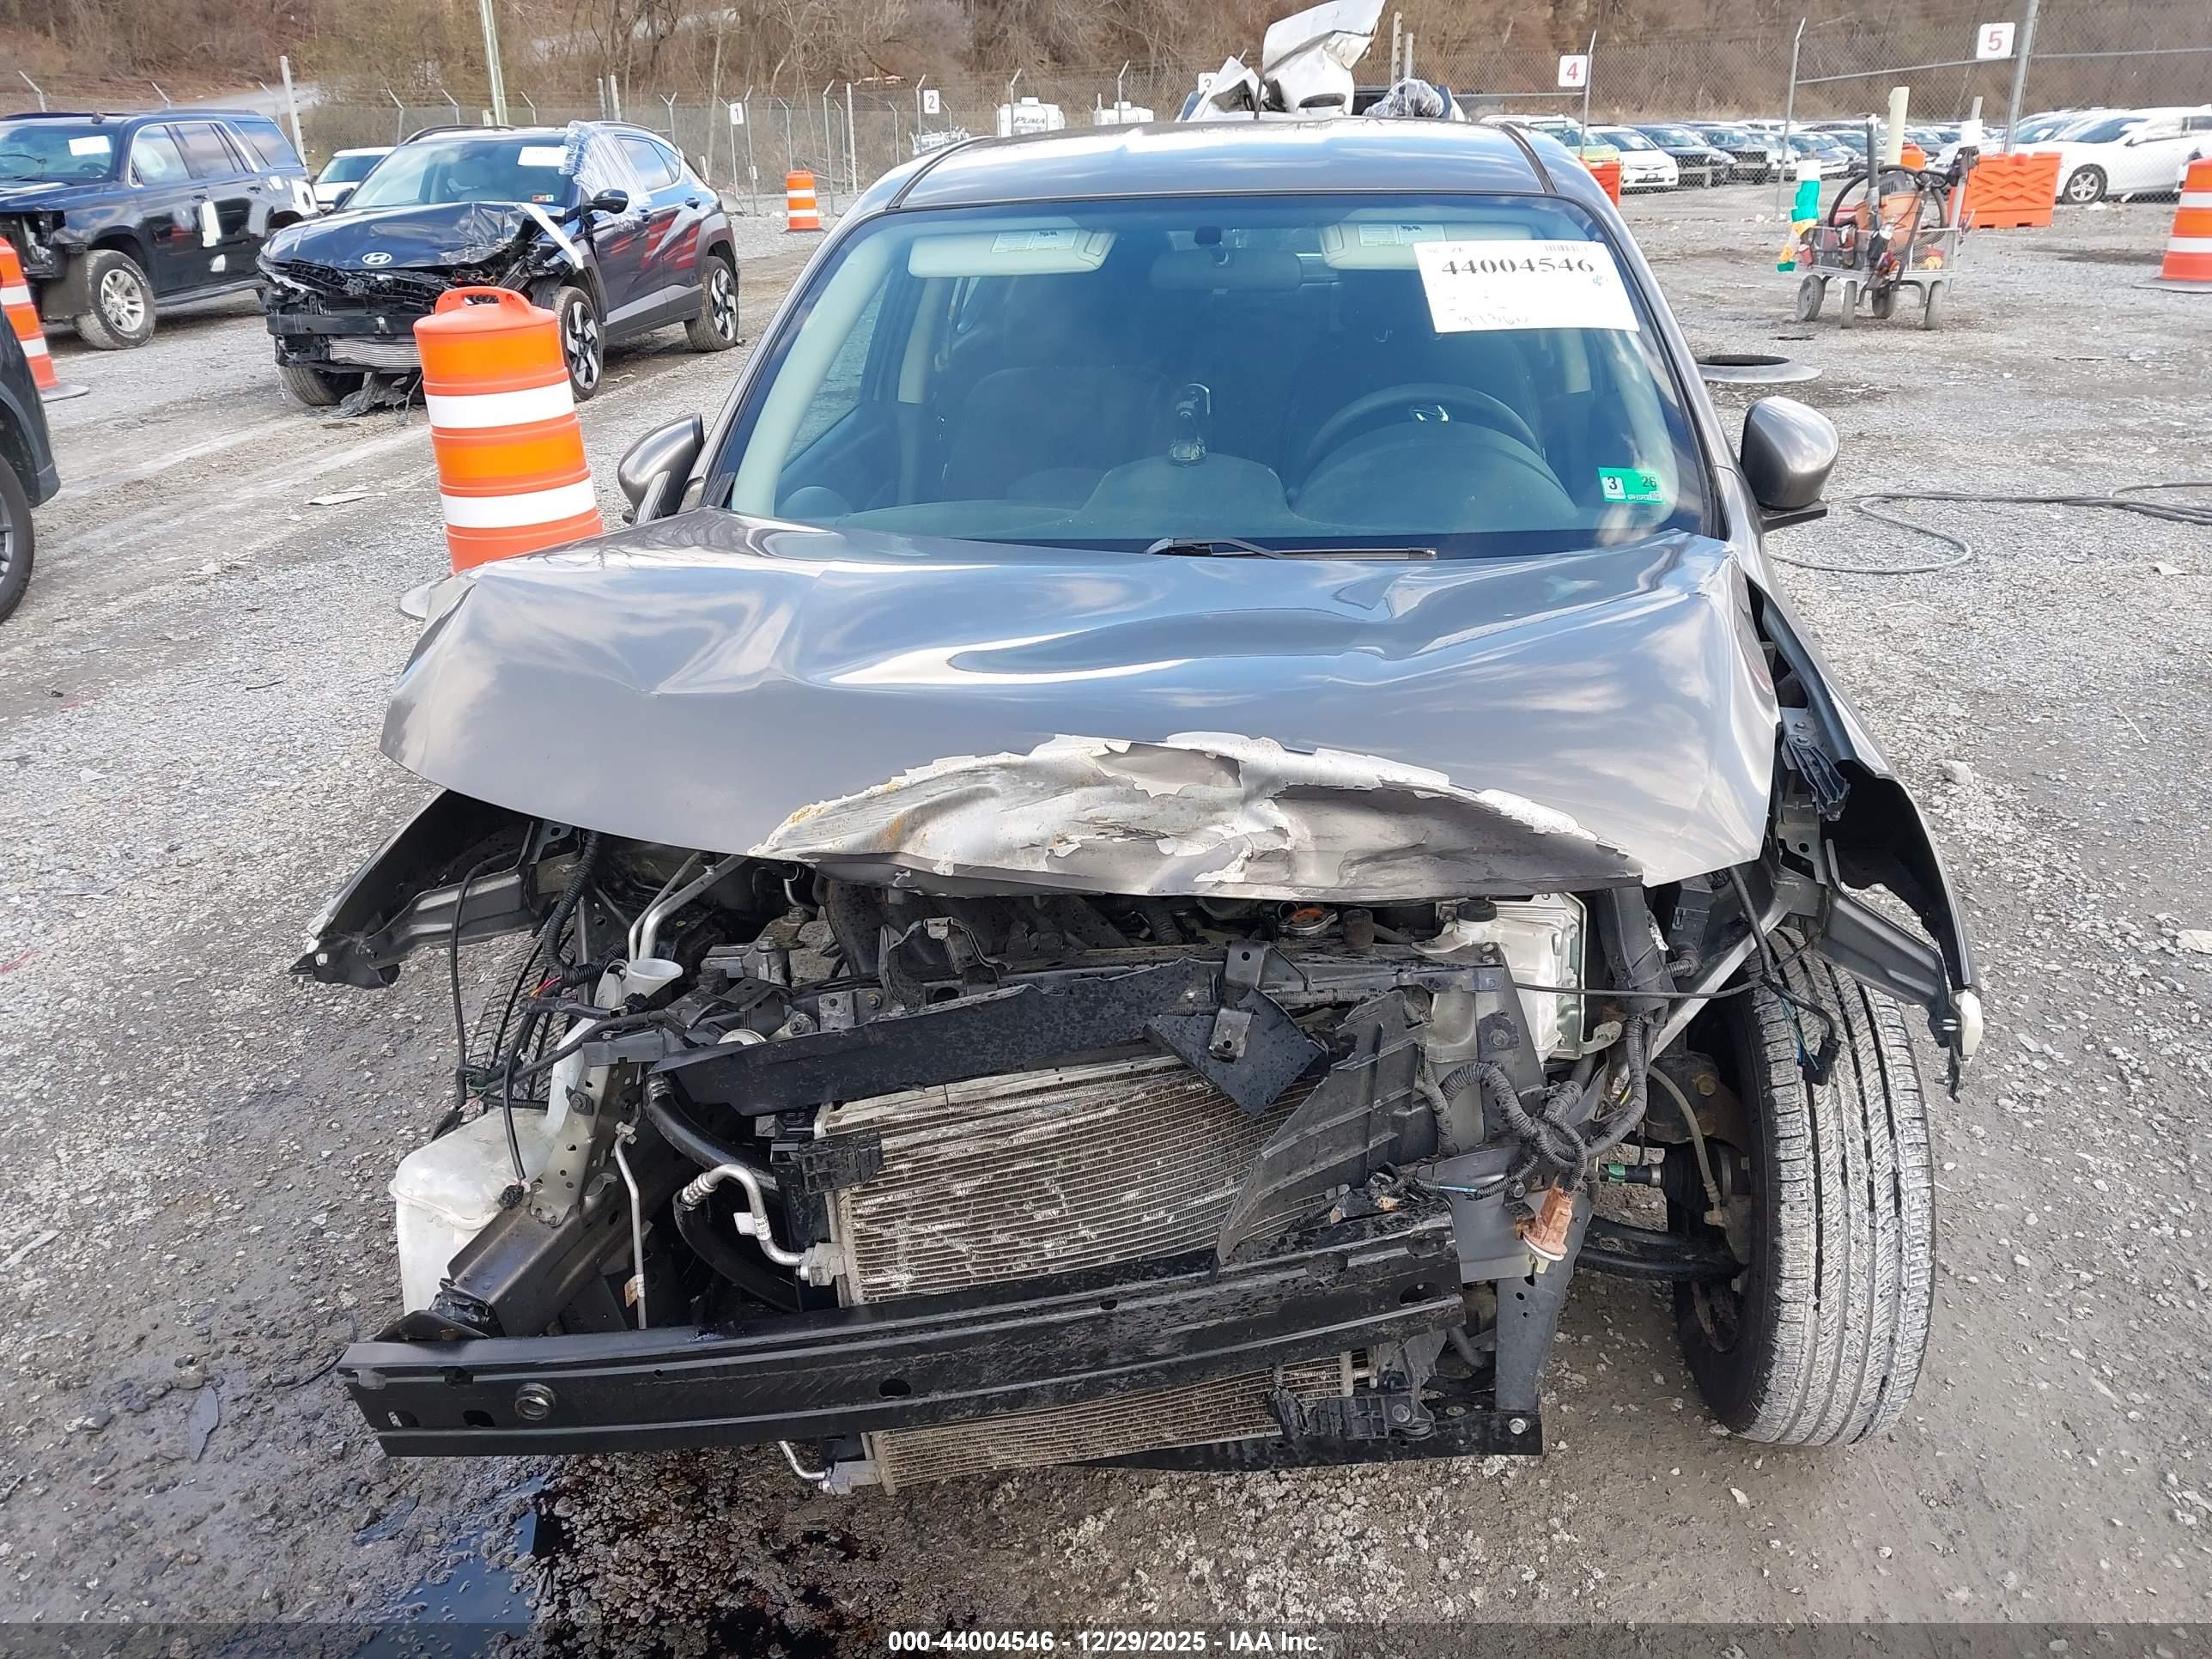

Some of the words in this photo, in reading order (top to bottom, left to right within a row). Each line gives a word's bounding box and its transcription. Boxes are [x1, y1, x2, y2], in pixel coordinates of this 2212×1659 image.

[1988, 30, 2002, 51] 5
[1566, 61, 1578, 80] 4
[928, 94, 935, 109] 2
[1014, 116, 1046, 125] PUMA
[1442, 258, 1595, 275] 44004546
[1607, 476, 1618, 489] 3
[1642, 476, 1657, 489] 26
